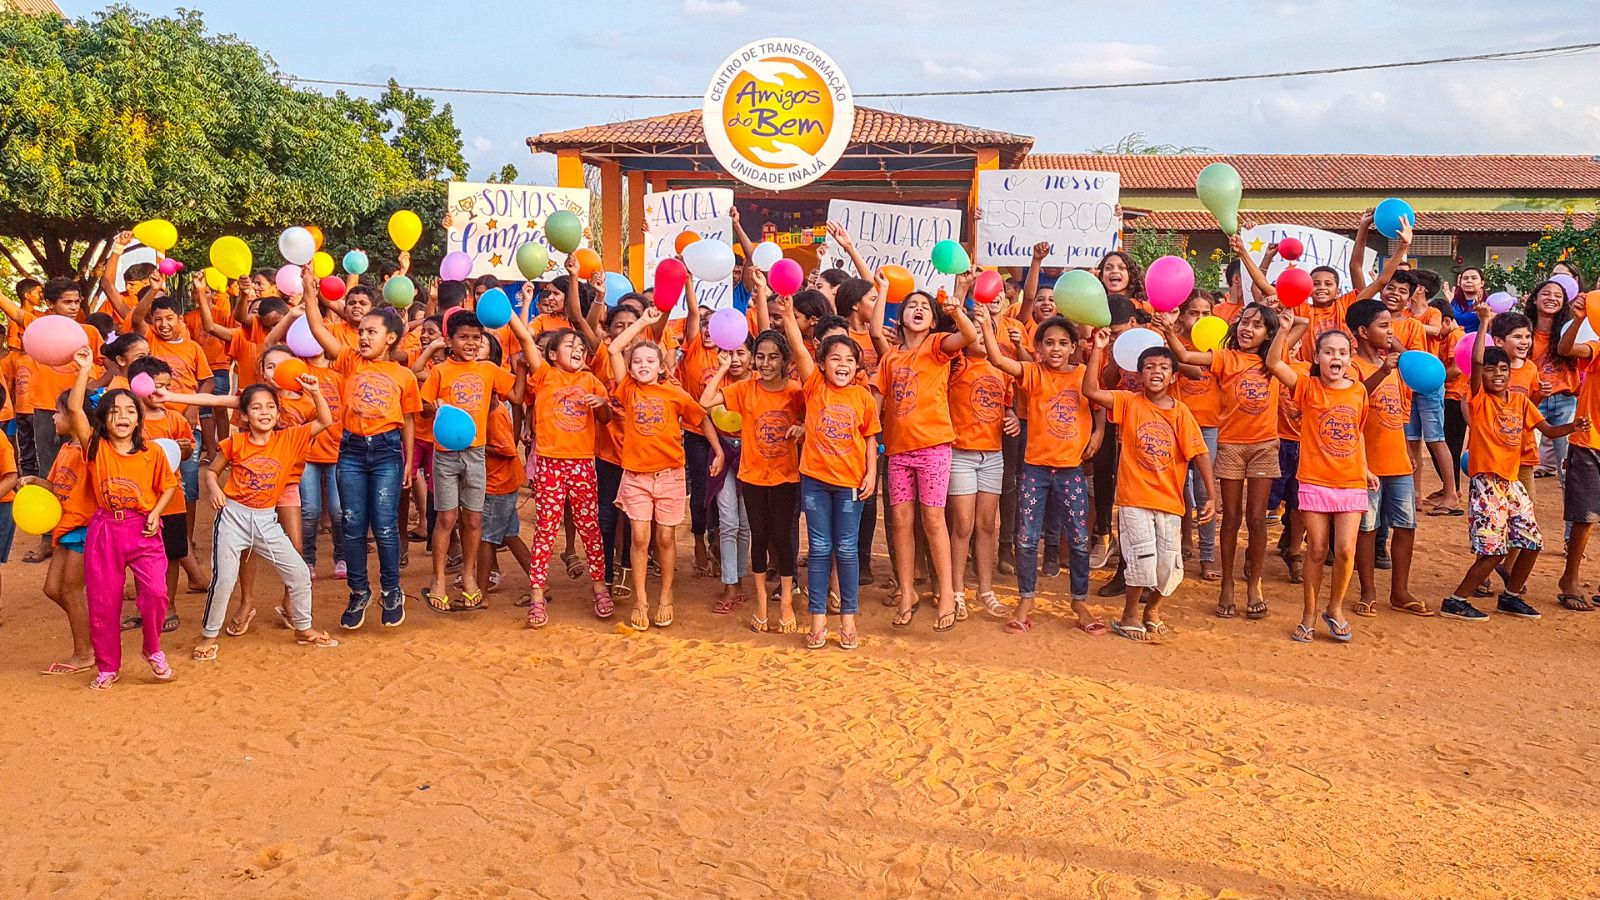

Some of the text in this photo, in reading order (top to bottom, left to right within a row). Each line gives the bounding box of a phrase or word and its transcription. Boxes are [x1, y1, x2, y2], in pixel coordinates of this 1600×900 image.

[711, 42, 847, 102] CENTRO DE TRANSFORMAÇÃO
[736, 80, 821, 110] Amigos
[728, 108, 825, 137] do Bem
[730, 157, 827, 184] UNIDADE INAJÁ
[1040, 175, 1112, 191] nosso
[480, 188, 559, 218] SOMOS
[651, 191, 720, 227] AGORA
[986, 199, 1113, 238] ESFORÇO
[983, 234, 1032, 257] valeu
